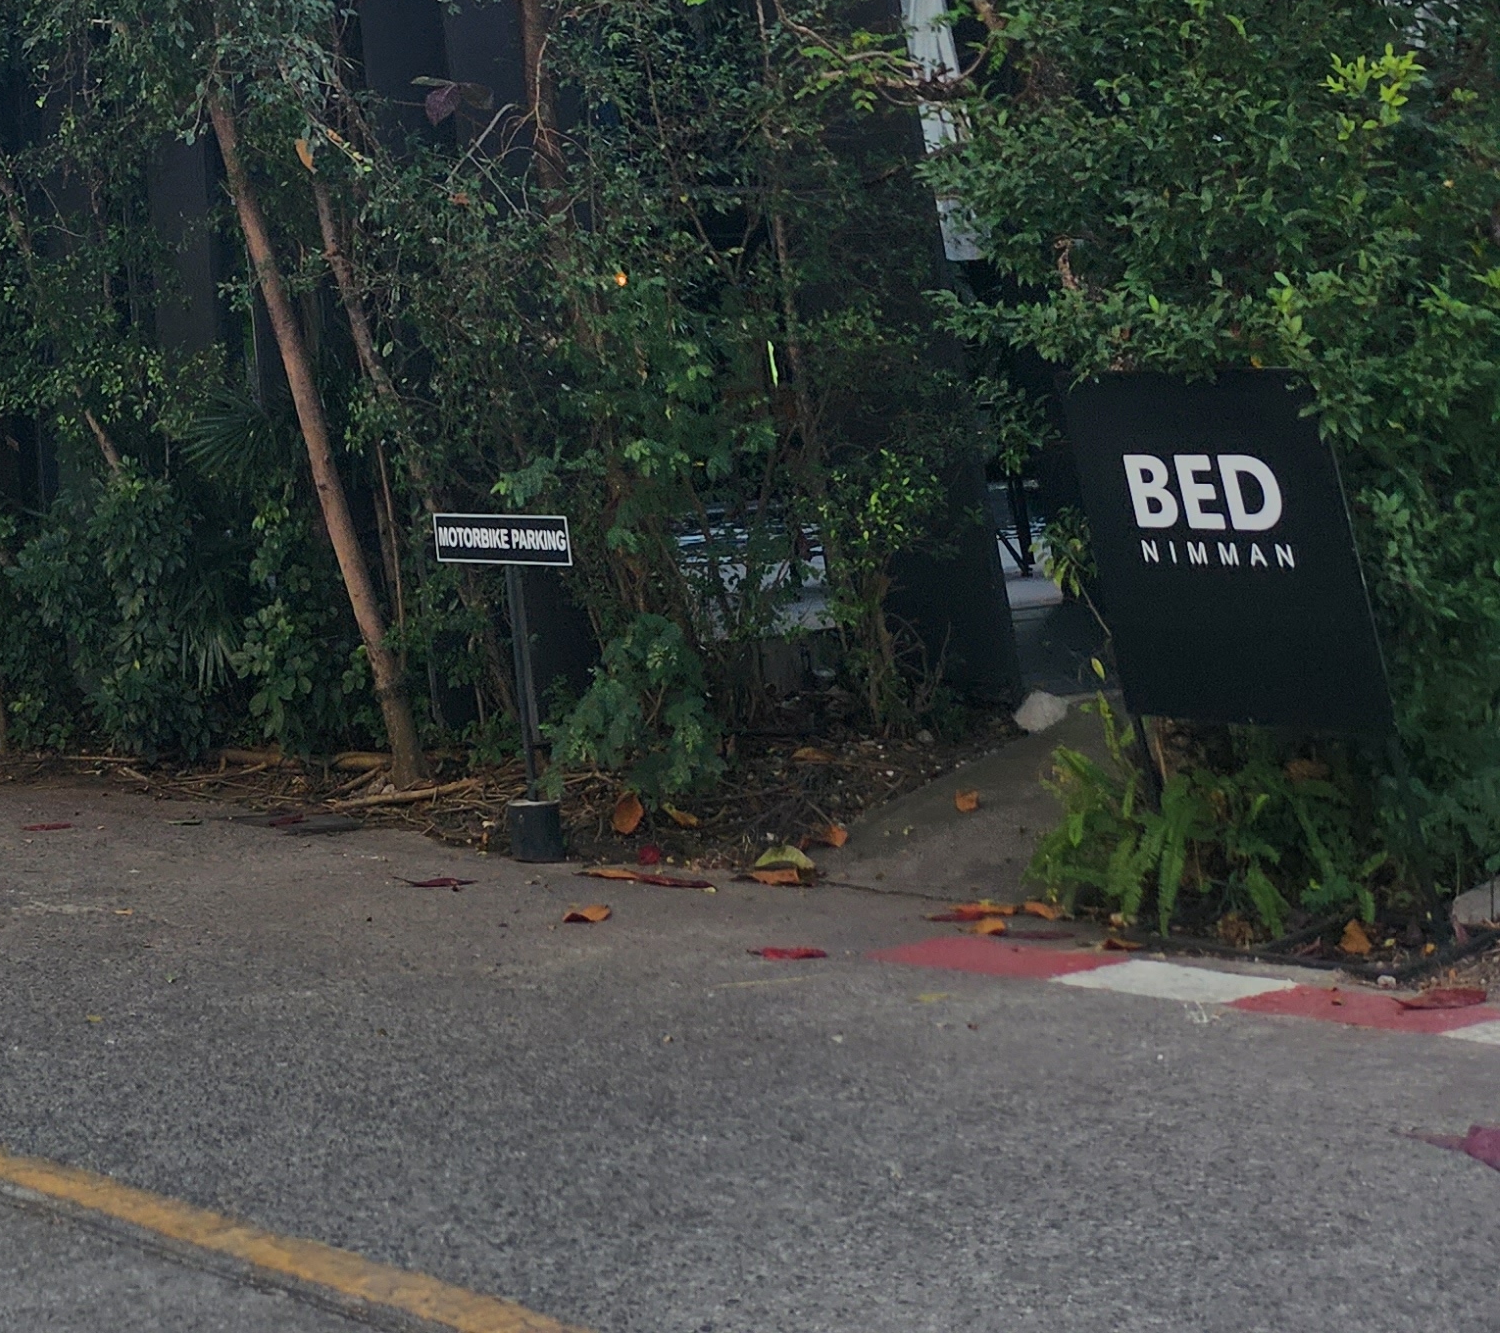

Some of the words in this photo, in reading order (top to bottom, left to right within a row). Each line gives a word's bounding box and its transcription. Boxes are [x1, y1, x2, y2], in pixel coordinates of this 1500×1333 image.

[1122, 454, 1283, 531] BED
[438, 526, 510, 550] MOTORBIKE
[511, 528, 567, 552] PARKING
[1140, 539, 1296, 569] NIMMAN
